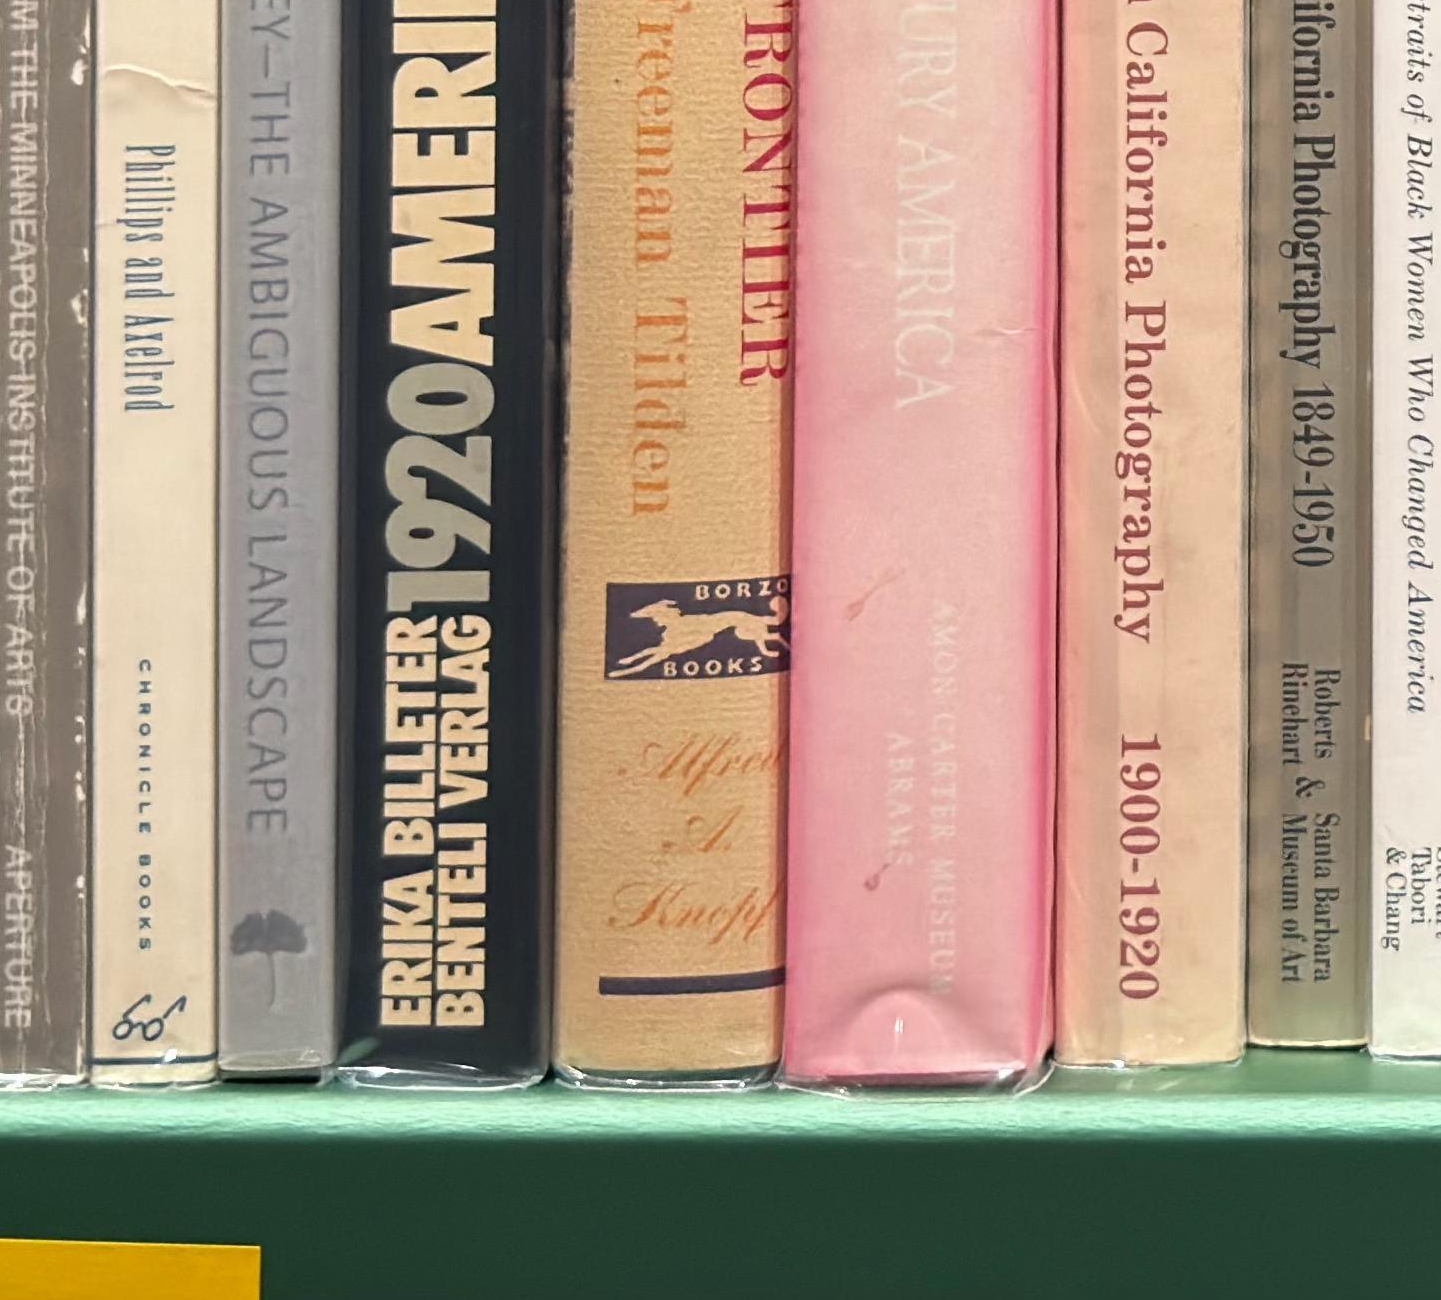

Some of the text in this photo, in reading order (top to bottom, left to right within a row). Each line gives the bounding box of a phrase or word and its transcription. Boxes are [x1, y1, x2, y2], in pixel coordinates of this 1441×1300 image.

[1124, 22, 1169, 284] California
[116, 144, 176, 413] Phillips and Axelrod
[630, 298, 689, 515] Tilden
[1114, 303, 1167, 643] Photography
[663, 657, 763, 677] BOOKS
[1281, 663, 1309, 764] Rinehart
[1314, 668, 1341, 759] Roberts
[137, 658, 153, 951] CHRONICLE BOOKS
[381, 615, 437, 1026] ERIKA BILLETER
[437, 615, 492, 1026] BENTELI VERLAG
[1118, 733, 1161, 1000] 1900-1920
[1314, 813, 1341, 983] Santa Barbara
[1411, 847, 1432, 924] Tabori
[3, 844, 33, 1028] APERTURE
